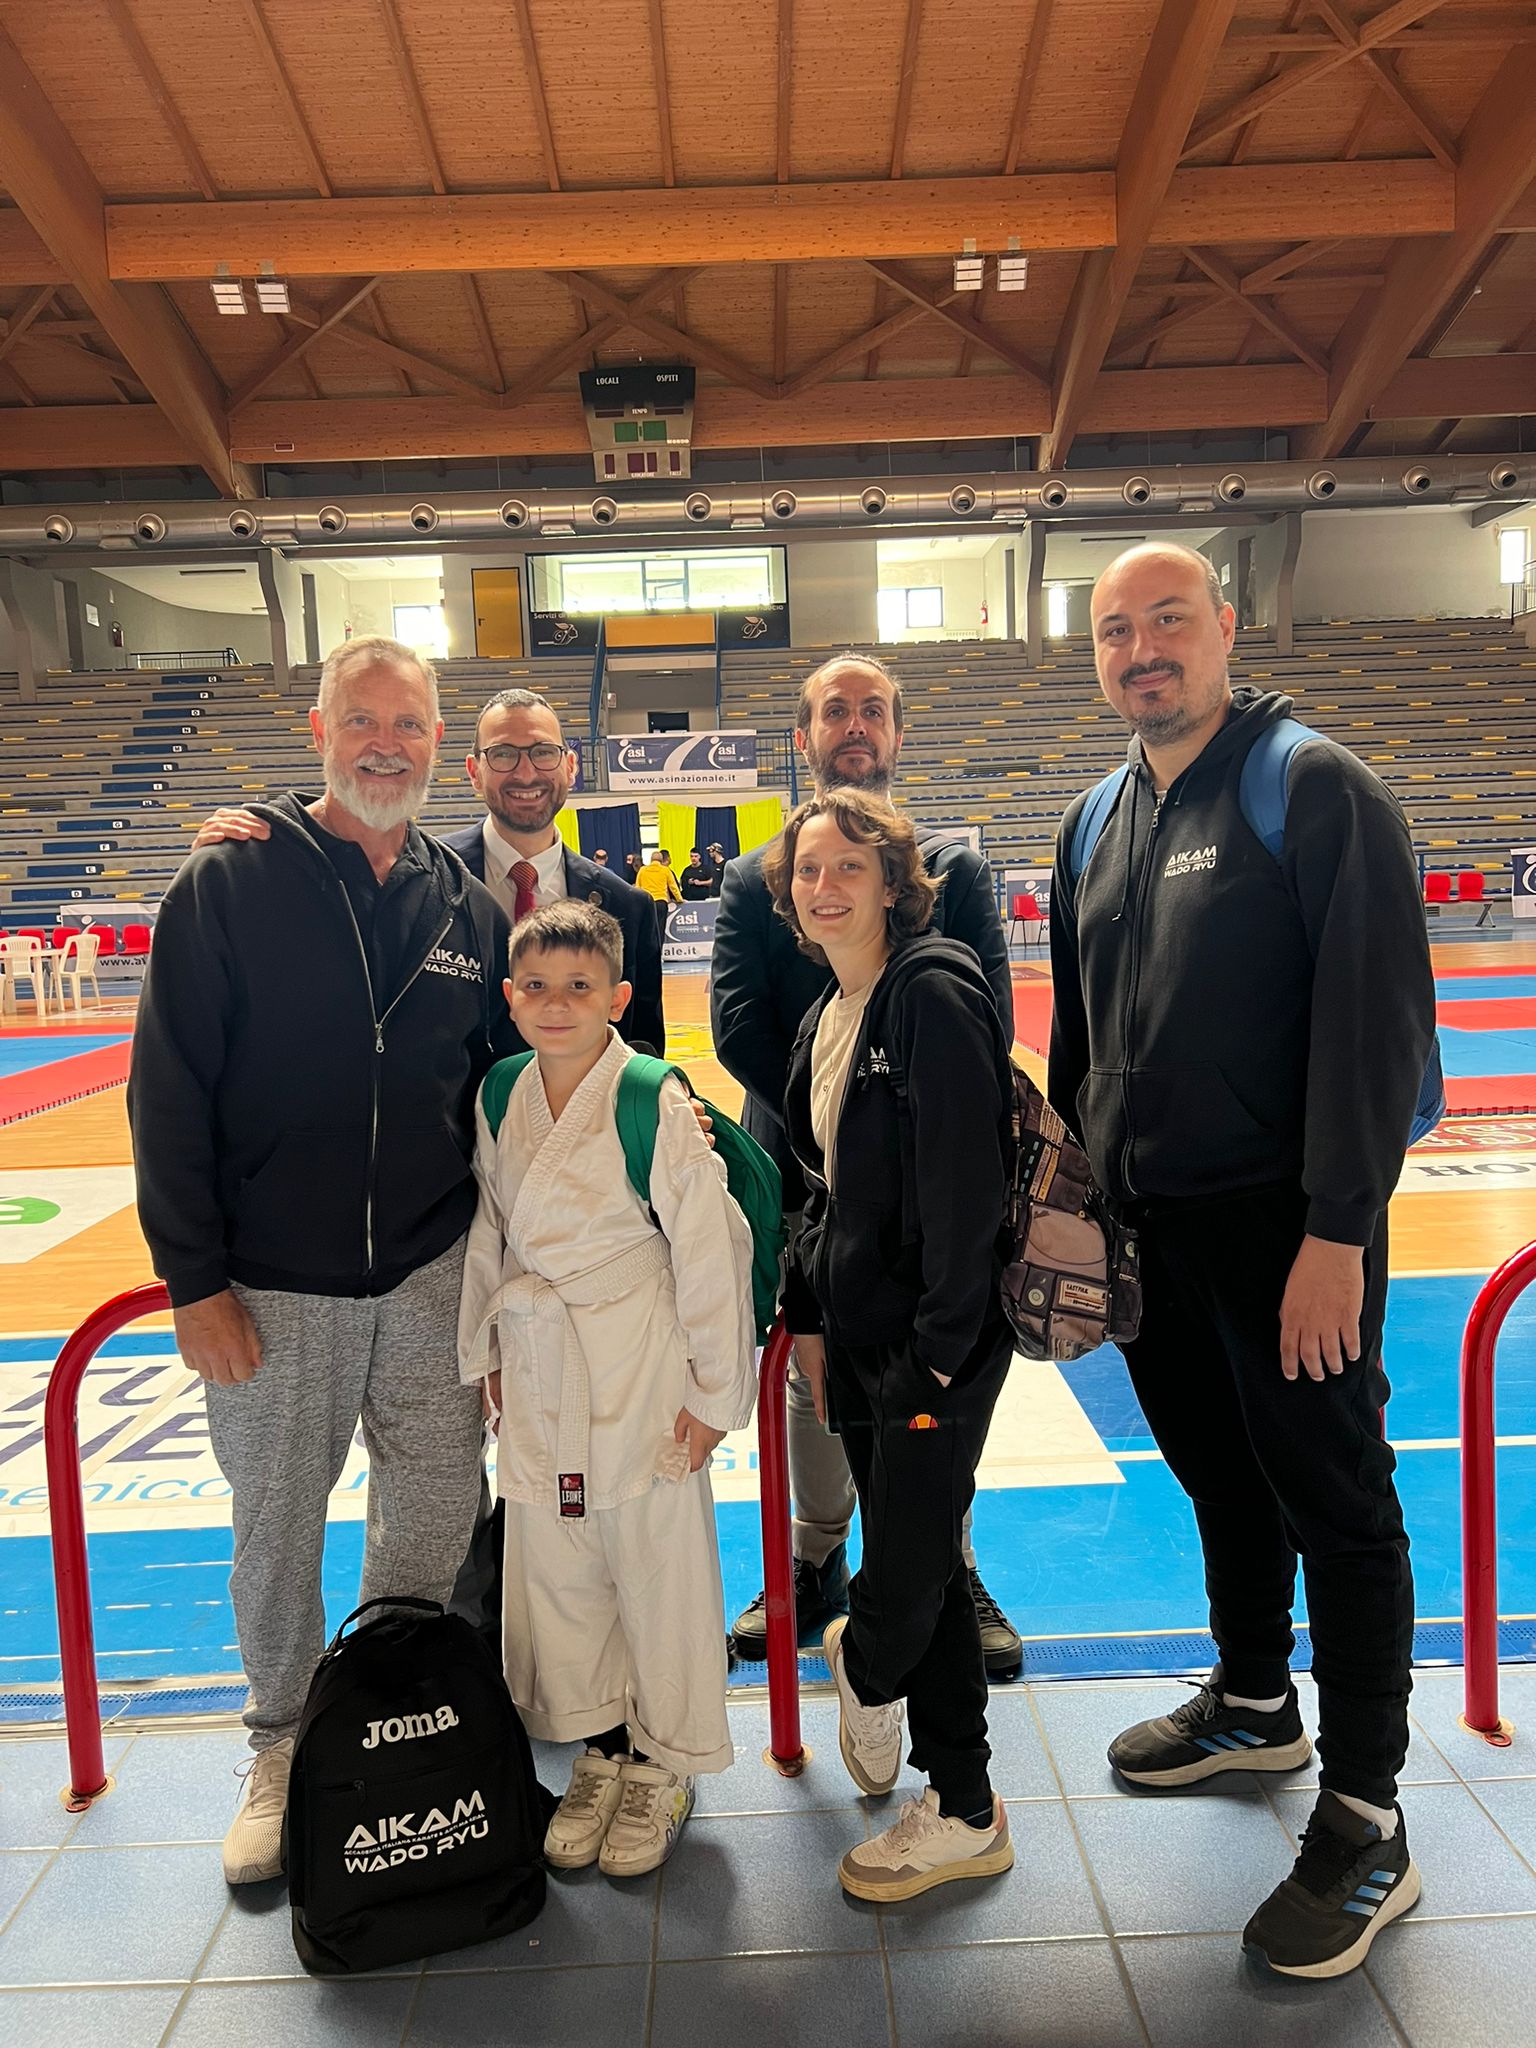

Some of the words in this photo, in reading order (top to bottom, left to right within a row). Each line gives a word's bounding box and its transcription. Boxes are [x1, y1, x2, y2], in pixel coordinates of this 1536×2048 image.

[596, 376, 620, 385] LOCALI
[656, 374, 679, 382] OSPITI
[627, 745, 646, 758] asi
[717, 743, 737, 755] asi
[628, 773, 736, 785] www.asinazionale.it
[1166, 845, 1217, 867] AIKAM
[1164, 865, 1191, 878] WADO
[1191, 860, 1216, 872] RYU
[675, 911, 699, 925] asi
[1408, 1162, 1536, 1177] HO
[343, 1789, 486, 1849] AIKAM
[344, 1843, 429, 1874] WADO
[436, 1819, 489, 1855] RYU
